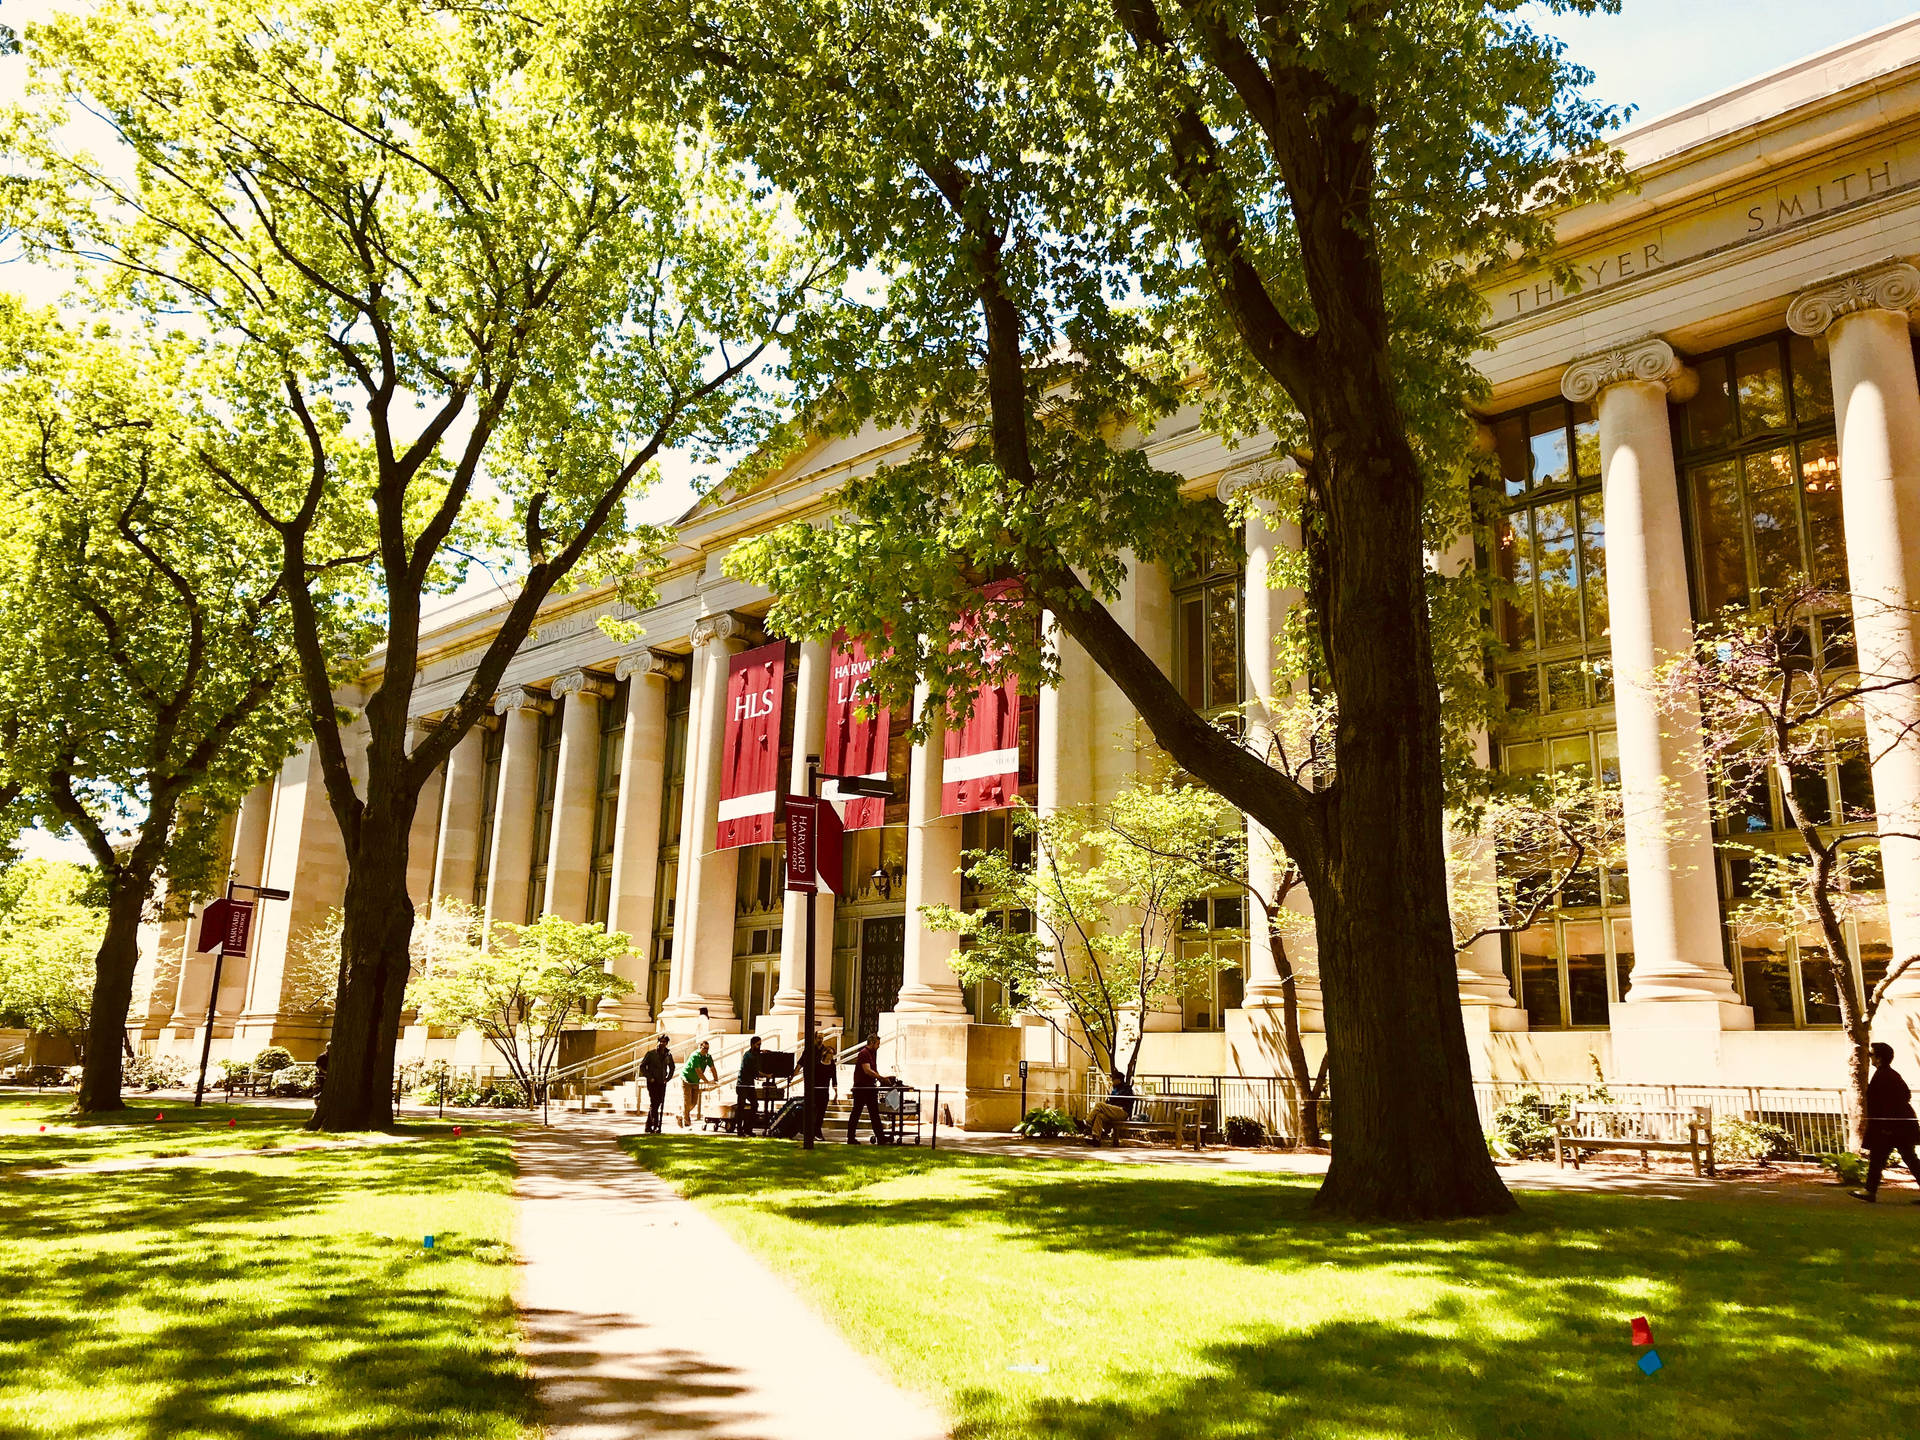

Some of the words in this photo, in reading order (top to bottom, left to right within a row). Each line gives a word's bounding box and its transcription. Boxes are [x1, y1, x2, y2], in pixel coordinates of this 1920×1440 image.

[1509, 243, 1664, 313] THYER
[1747, 160, 1893, 232] SMITH
[447, 652, 481, 674] LANGD
[834, 657, 880, 680] HARVA
[734, 688, 774, 722] HLS
[797, 815, 808, 873] HARVARD
